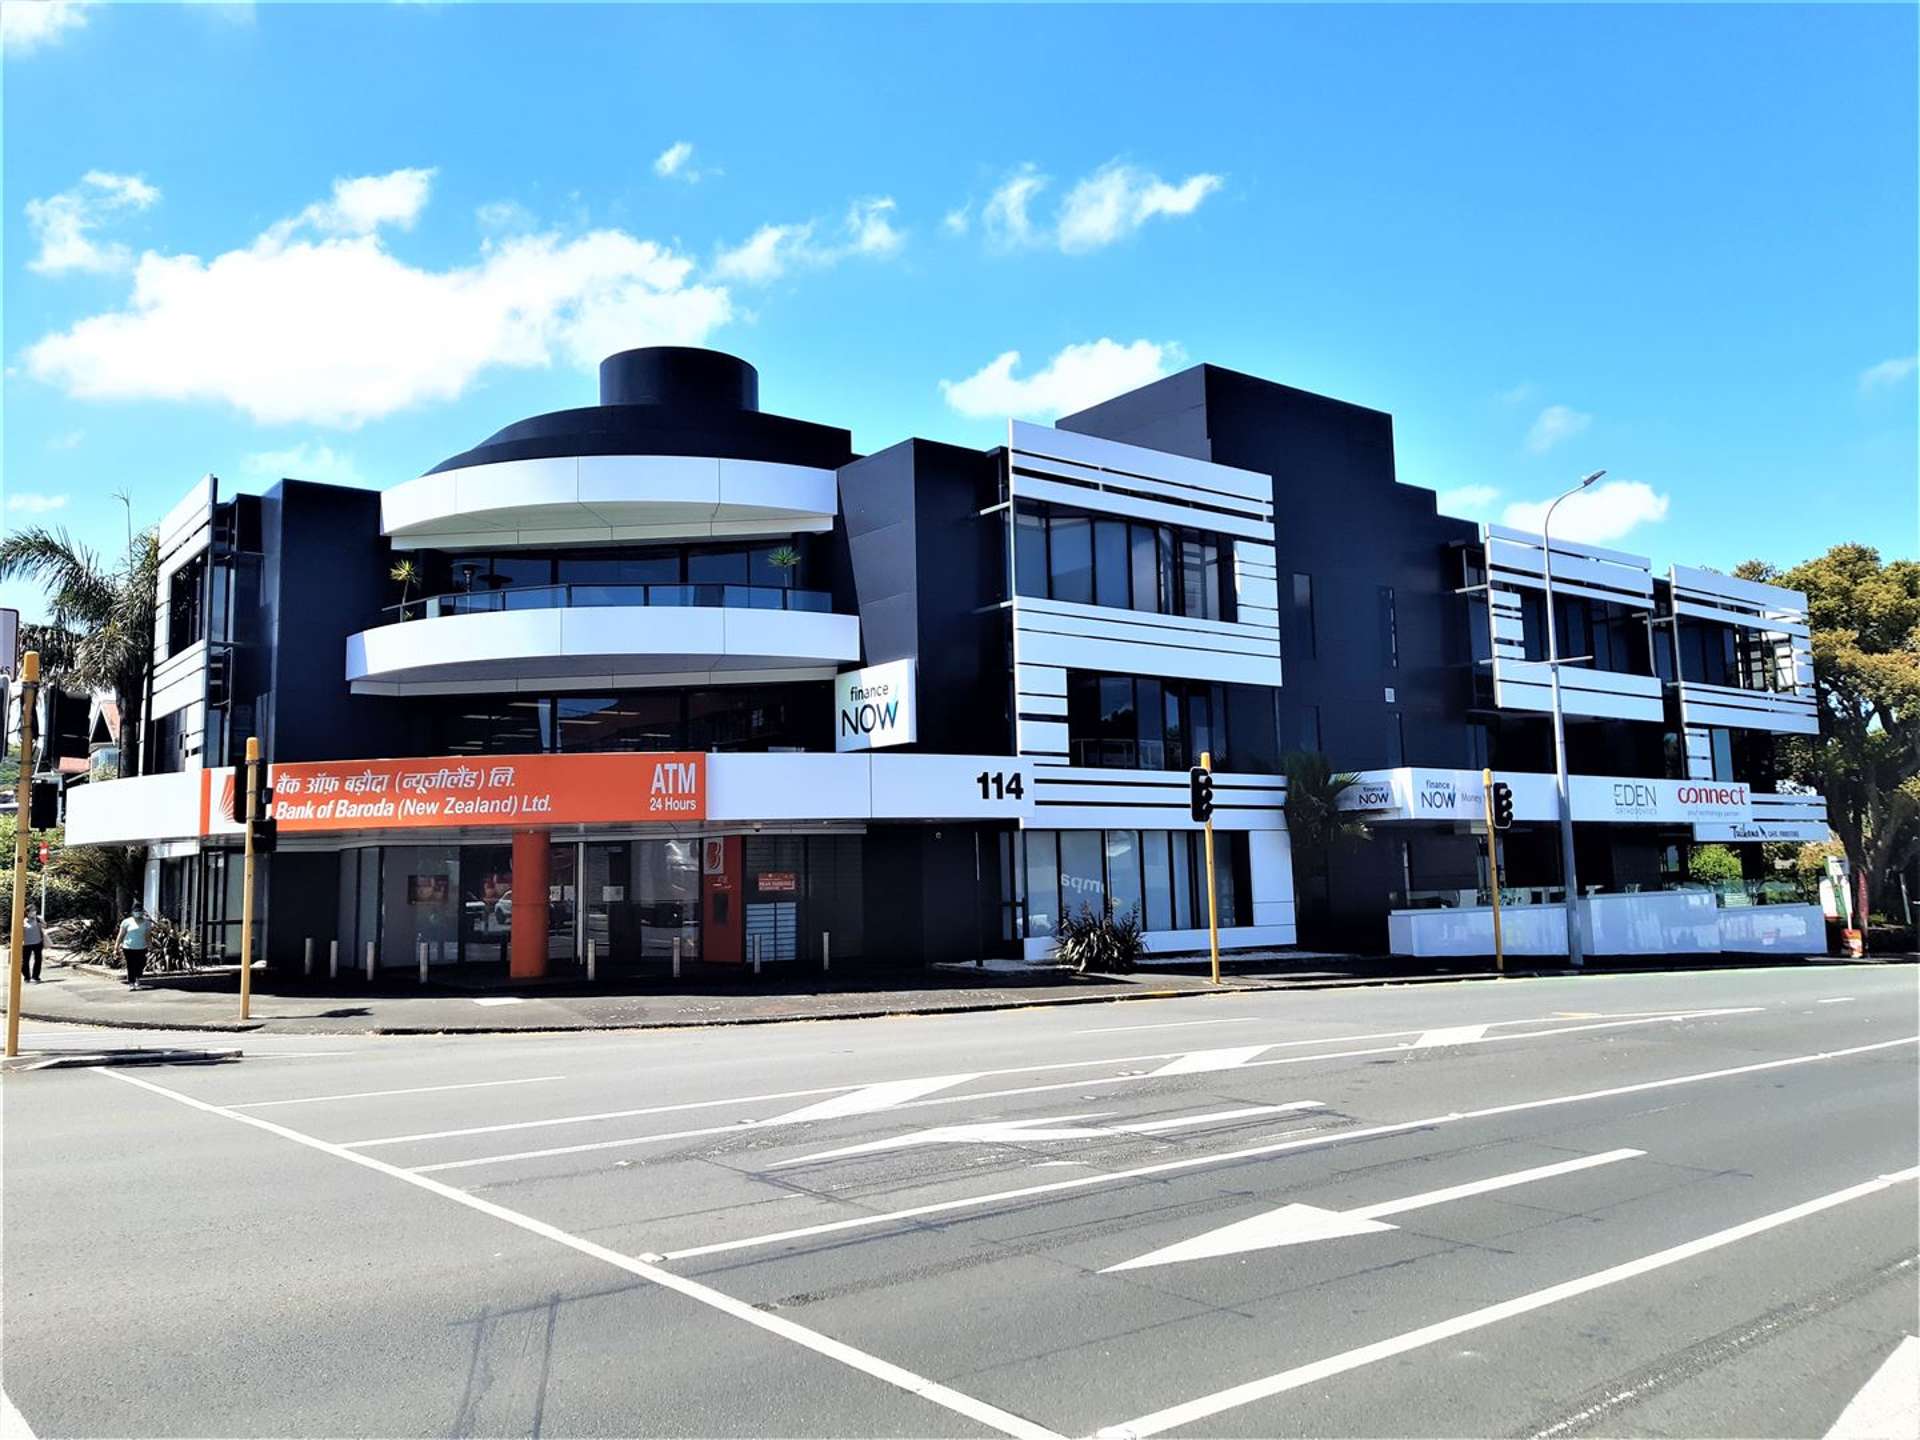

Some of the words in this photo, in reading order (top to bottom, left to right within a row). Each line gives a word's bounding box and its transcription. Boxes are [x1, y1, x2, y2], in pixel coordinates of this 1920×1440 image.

[850, 683, 889, 702] finance
[842, 701, 899, 737] NOW
[276, 772, 302, 794] बैंक
[650, 763, 696, 795] ATM
[976, 772, 1025, 800] 114
[1426, 780, 1450, 790] finance
[650, 797, 663, 811] 24
[664, 797, 697, 811] Hours
[1359, 792, 1390, 805] NOW
[1421, 789, 1457, 809] NOW
[1613, 784, 1657, 806] EDEN
[1678, 787, 1745, 806] connect
[275, 801, 314, 820] Bank
[316, 800, 336, 818] of
[335, 798, 395, 818] Baroda
[398, 797, 440, 821] (New
[444, 795, 519, 816] Zealand)
[522, 795, 552, 812] Ltd.
